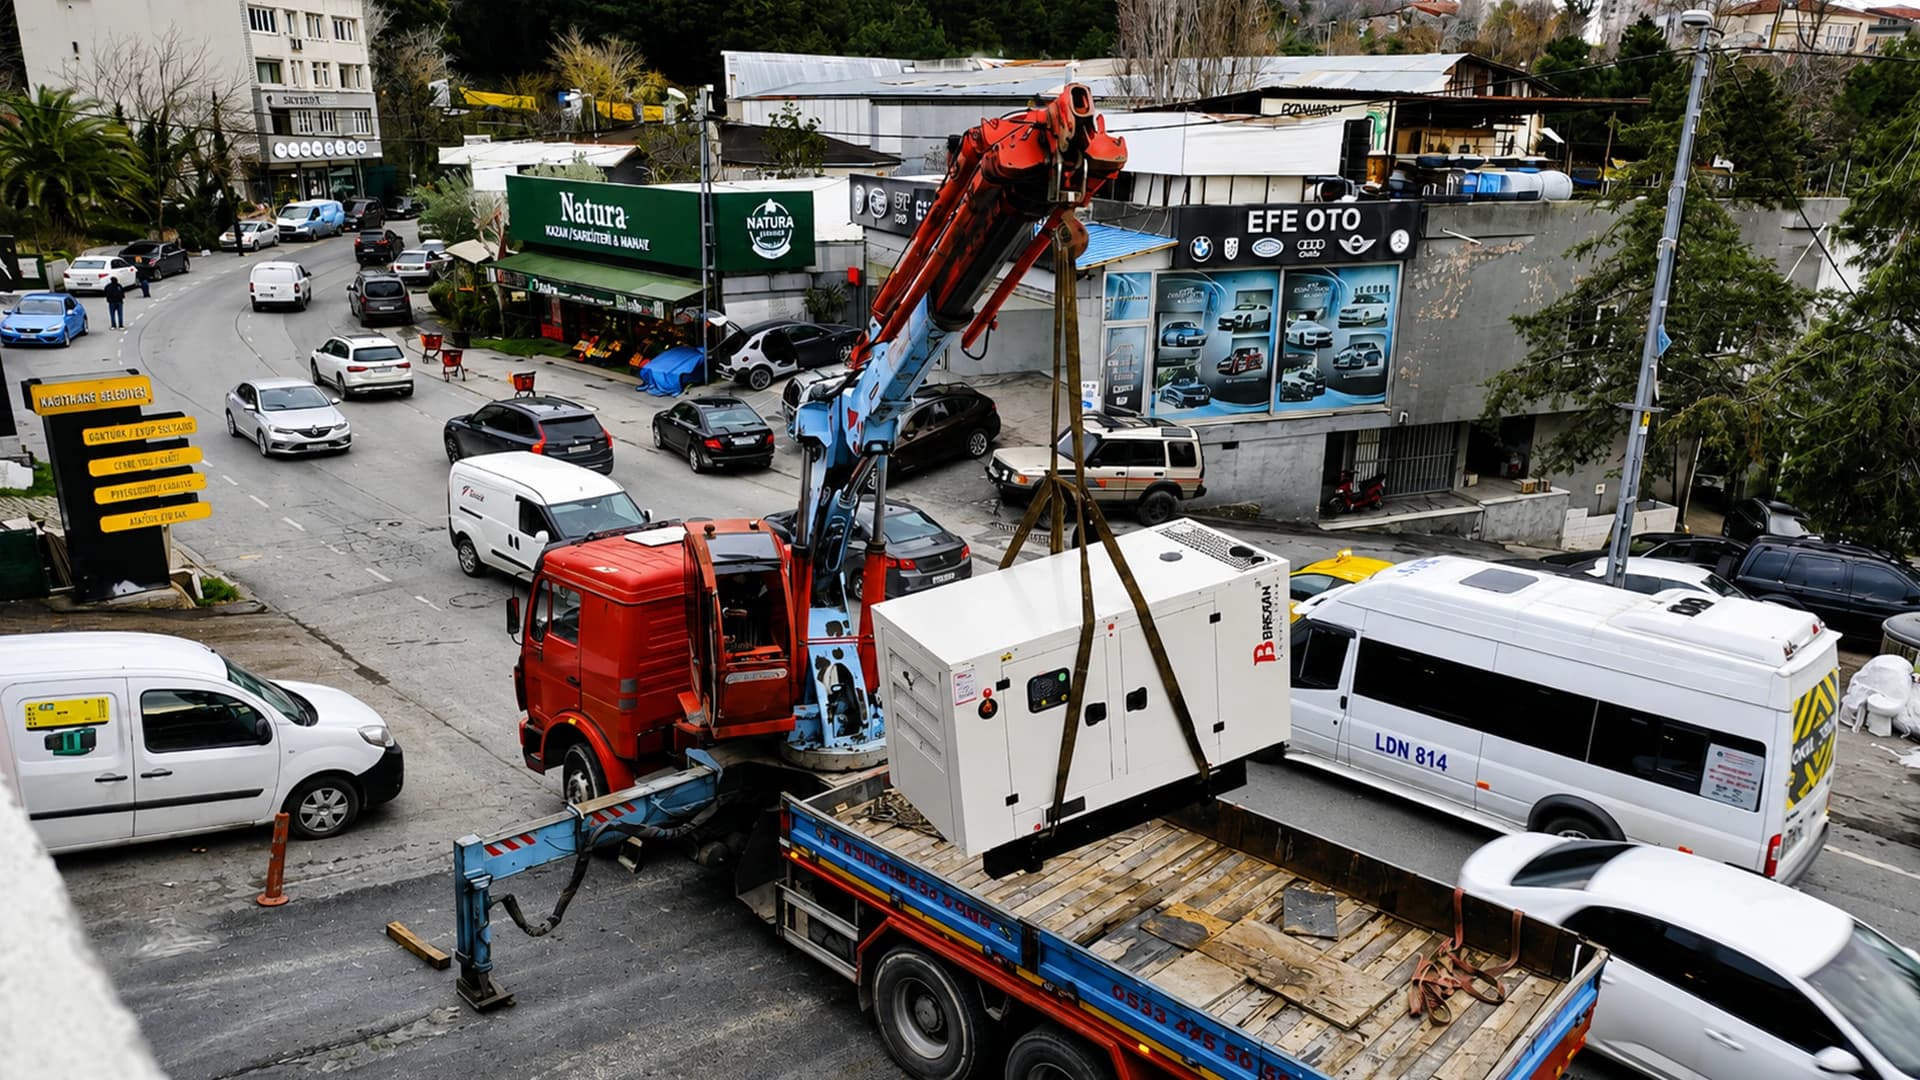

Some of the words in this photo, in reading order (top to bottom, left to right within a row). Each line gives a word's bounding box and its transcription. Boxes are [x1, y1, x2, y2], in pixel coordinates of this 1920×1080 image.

[559, 191, 627, 229] Natura
[747, 216, 794, 229] NATURA
[1248, 209, 1298, 233] EFE
[1305, 208, 1361, 232] OTO
[1375, 732, 1410, 760] LDN
[1415, 746, 1447, 772] 814
[1112, 985, 1167, 1024] 0533
[1224, 1044, 1253, 1070] 50
